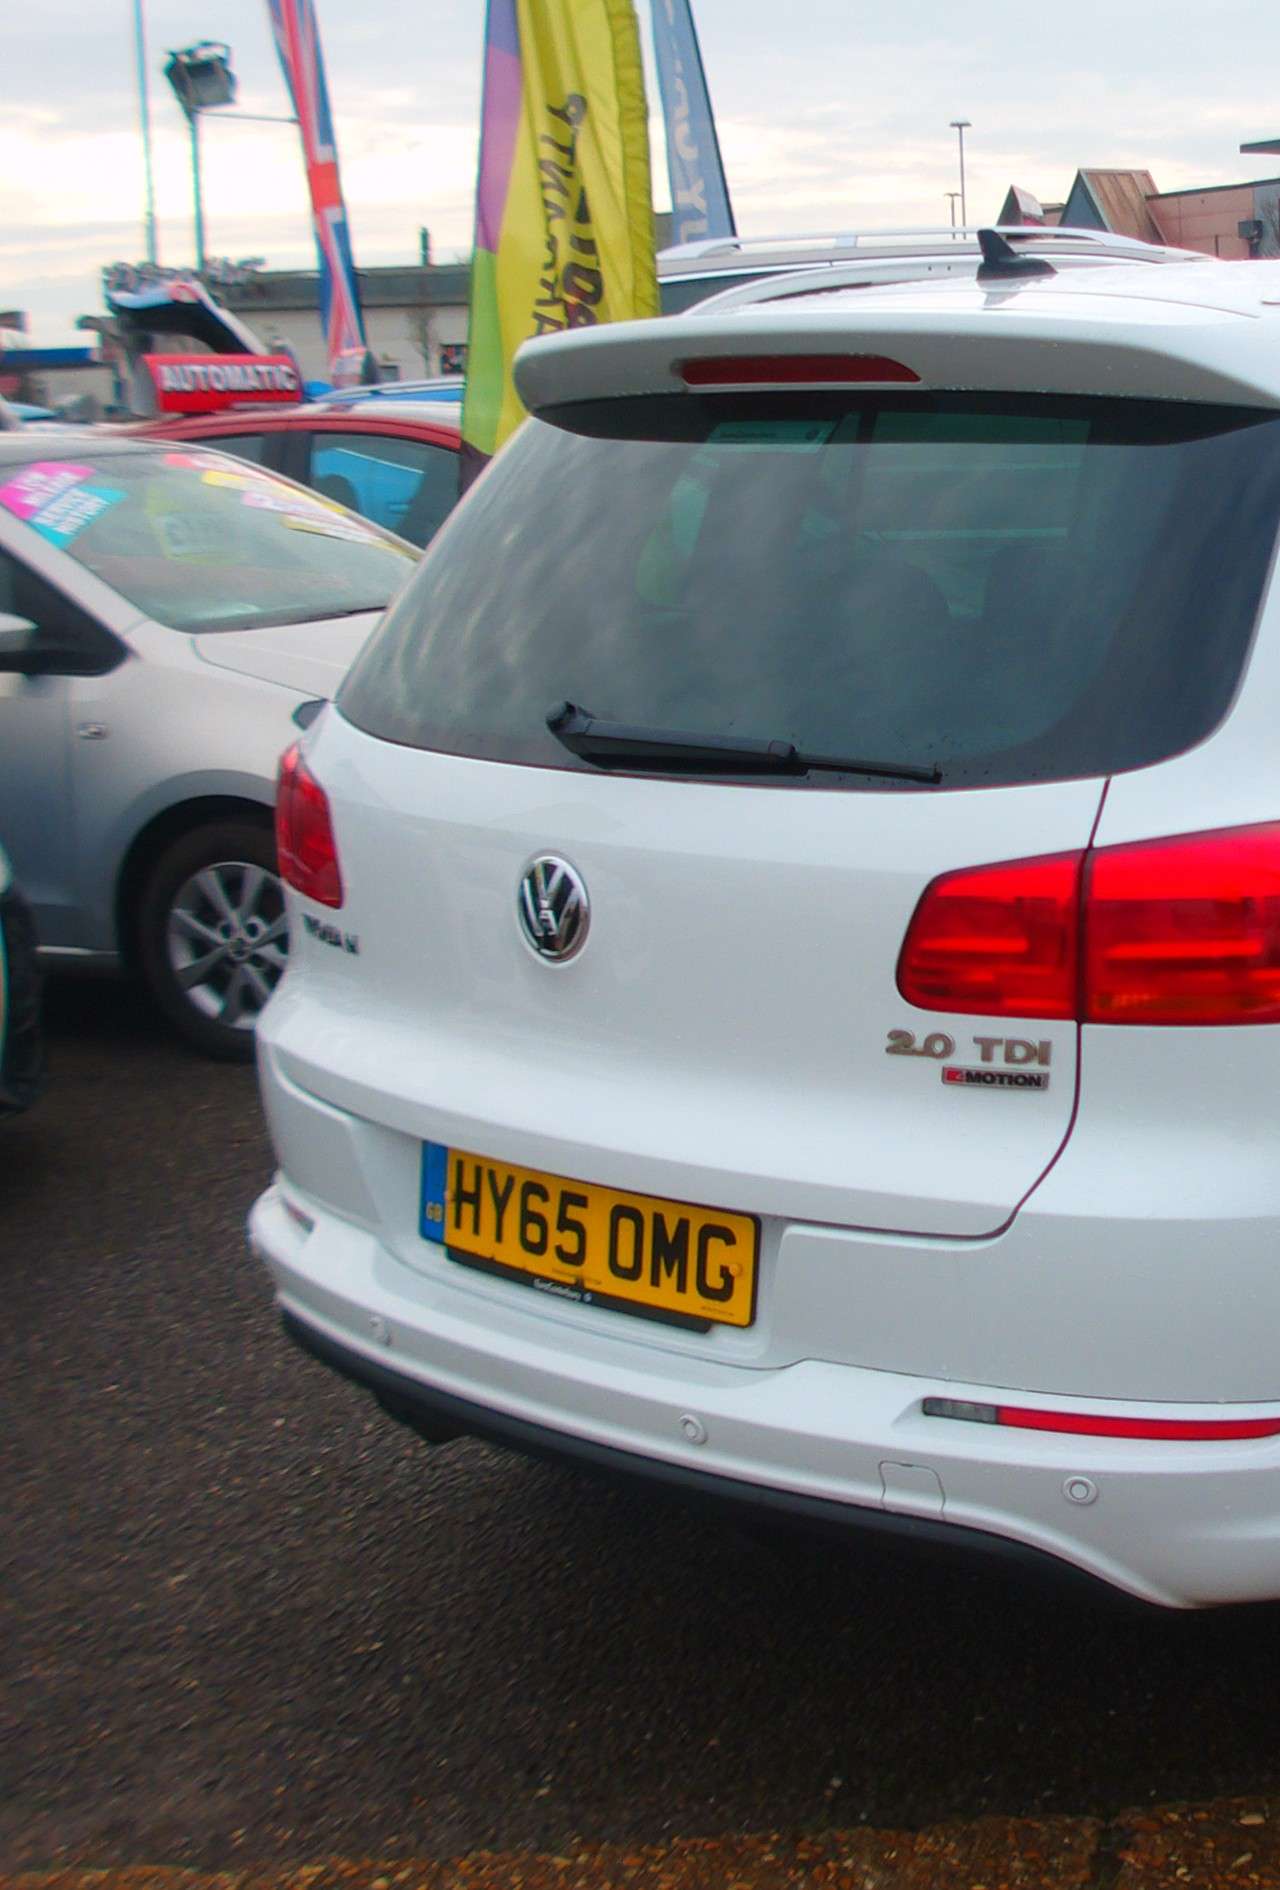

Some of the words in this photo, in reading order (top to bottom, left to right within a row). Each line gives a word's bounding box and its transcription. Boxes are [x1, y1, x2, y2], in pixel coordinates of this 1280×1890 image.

[159, 364, 297, 391] AUTOMATIC
[973, 1035, 1053, 1065] TDI
[453, 1158, 590, 1267] HY65
[608, 1203, 738, 1302] OMG
